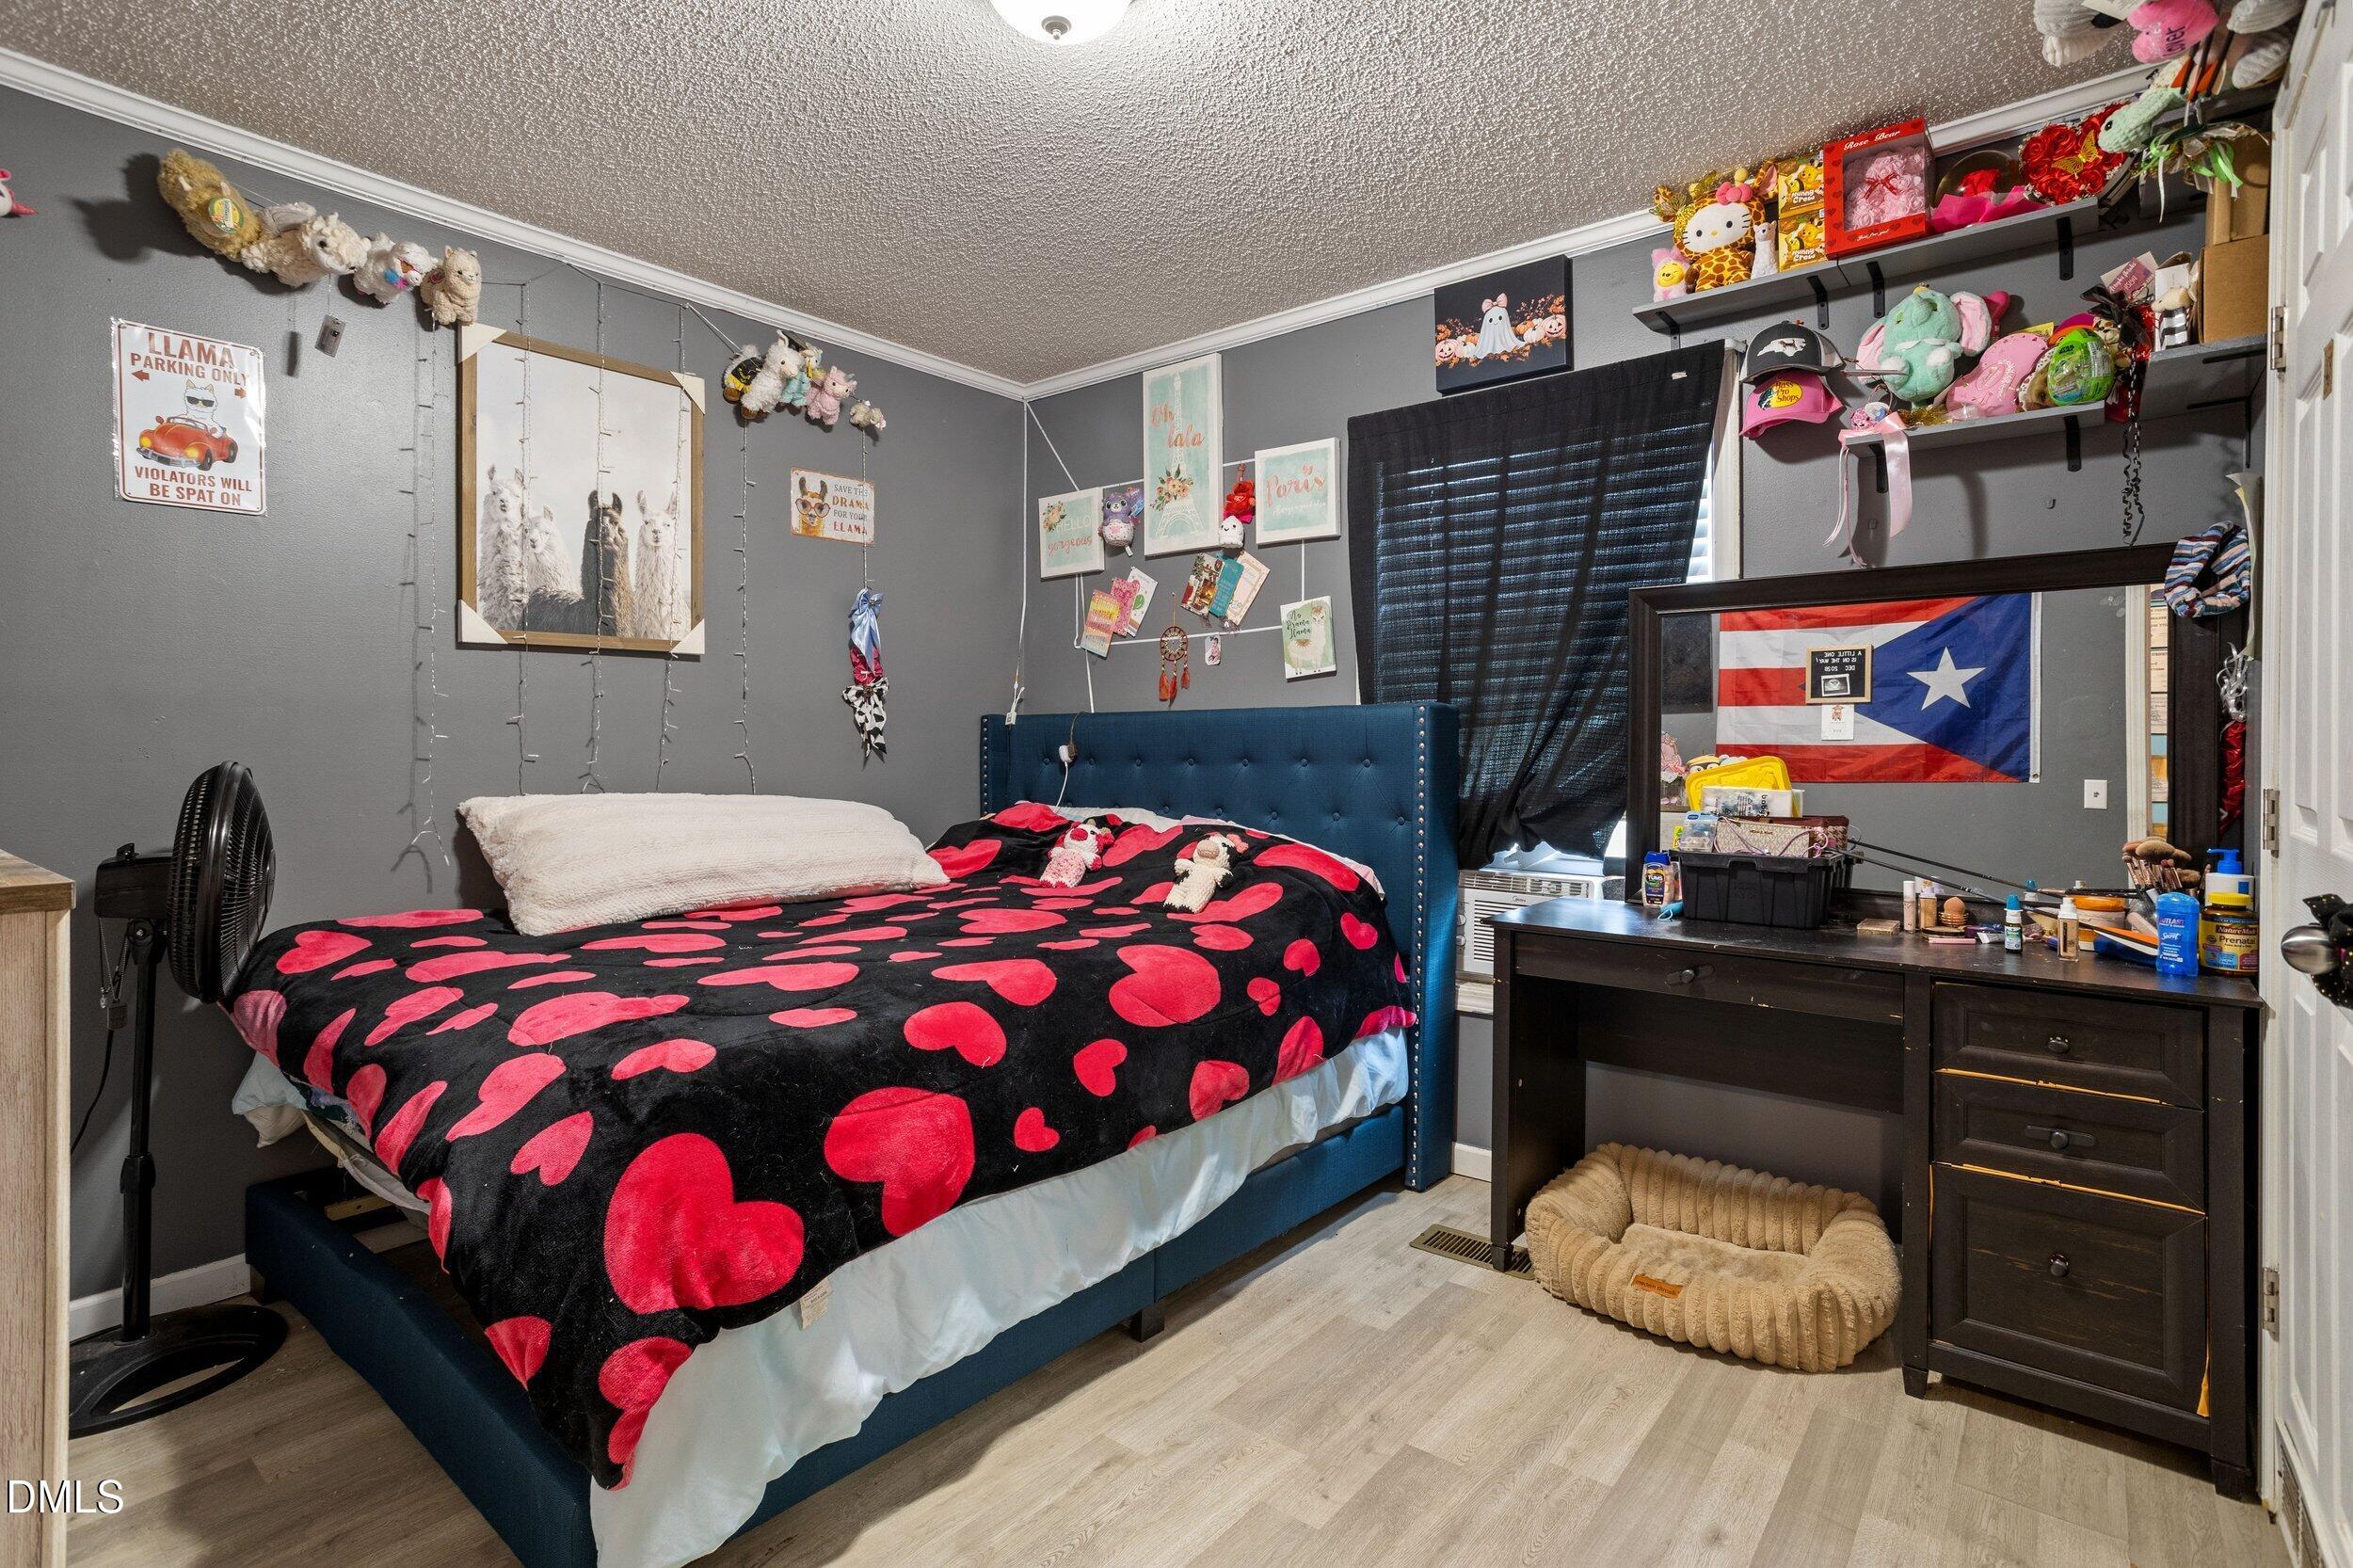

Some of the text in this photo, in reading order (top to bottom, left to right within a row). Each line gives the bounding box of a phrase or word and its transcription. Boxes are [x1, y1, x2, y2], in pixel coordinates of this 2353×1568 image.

[1844, 130, 1900, 152] Rose Bear
[1792, 189, 1815, 199] Hunny
[1793, 196, 1816, 204] Crew
[1792, 248, 1815, 256] Hunny
[1793, 253, 1816, 263] Crew
[148, 332, 236, 369] LLAMA
[130, 353, 249, 387] PARKING ONLY
[1777, 394, 1800, 403] Shops
[1150, 402, 1176, 428] Oh
[1166, 423, 1205, 449] lala
[135, 466, 252, 492] VIOLATORS WILL
[150, 483, 241, 506] BE SPAT ON
[834, 484, 868, 497] SAVE THE
[1266, 469, 1326, 507] Paris
[832, 495, 870, 510] DRAMA
[833, 509, 868, 521] FOR YOUR
[833, 521, 868, 536] LLAMA
[1056, 515, 1091, 534] HELLO
[1048, 536, 1093, 557] gorgeous
[1287, 610, 1302, 622] No
[1287, 619, 1310, 630] Drama
[2161, 932, 2181, 940] Secret
[2219, 936, 2256, 945] Prenatal
